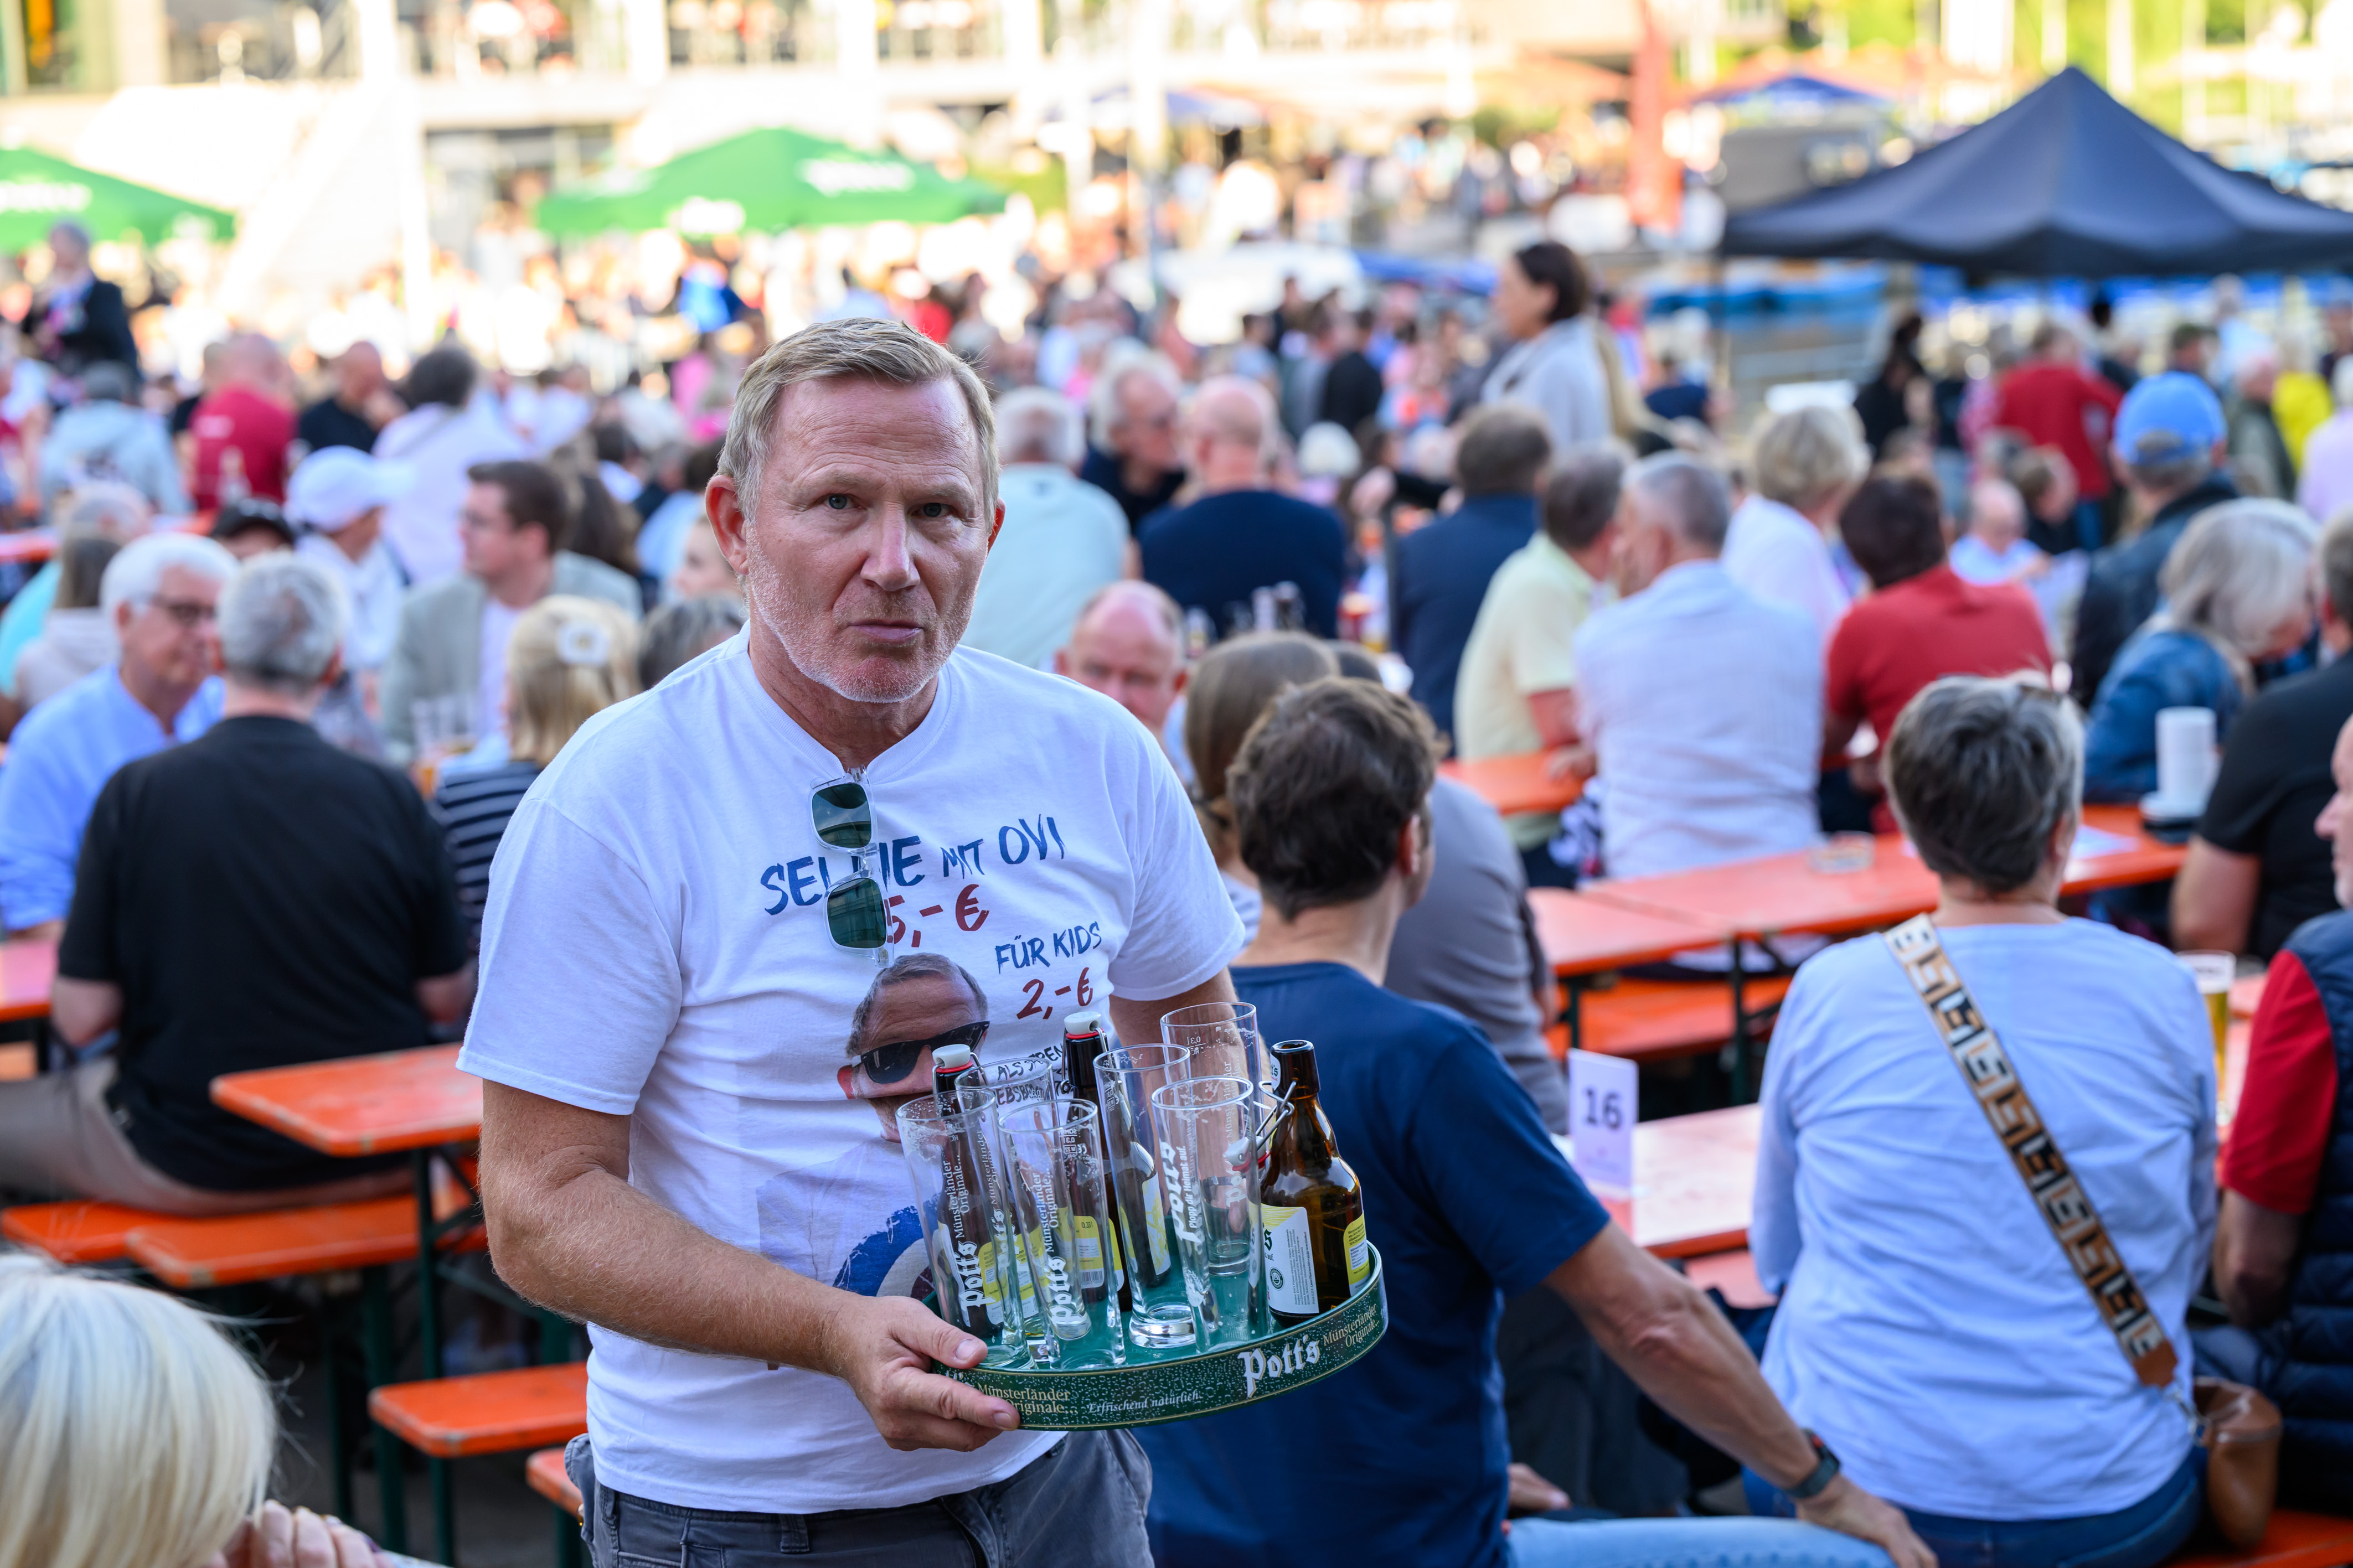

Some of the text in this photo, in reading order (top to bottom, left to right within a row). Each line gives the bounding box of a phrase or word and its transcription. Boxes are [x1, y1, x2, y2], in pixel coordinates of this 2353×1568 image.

[760, 835, 925, 916] SELIE
[998, 814, 1066, 865] OVI
[994, 921, 1102, 974] FÜR KIDS
[1583, 1088, 1623, 1131] 16
[1180, 1162, 1192, 1191] Heimat
[943, 1161, 965, 1239] Münsterländer
[1032, 1172, 1054, 1253] Münsterländer
[1185, 1193, 1194, 1205] dir
[1187, 1206, 1198, 1228] Plopp
[1322, 1303, 1377, 1347] Münsterländer
[1237, 1334, 1320, 1399] Pott's
[978, 1383, 1071, 1401] Münsterländer
[1087, 1396, 1149, 1417] Erfrischend
